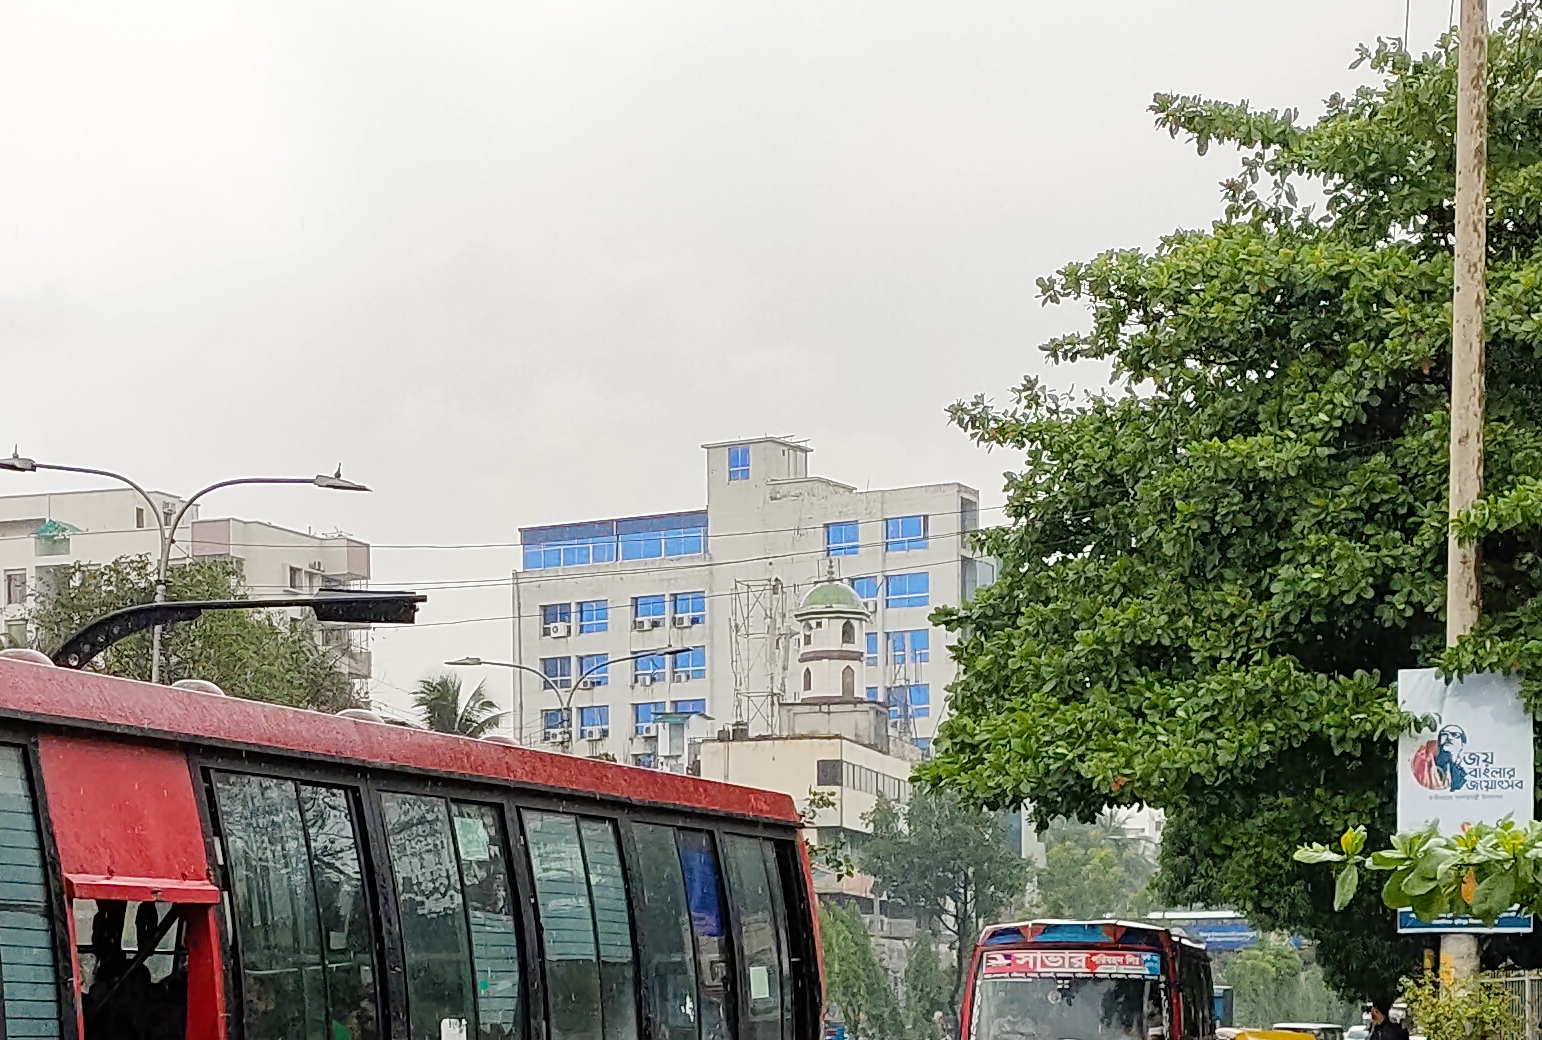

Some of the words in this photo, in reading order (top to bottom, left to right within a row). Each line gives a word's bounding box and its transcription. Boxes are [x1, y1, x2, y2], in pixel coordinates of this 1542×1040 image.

[1462, 751, 1494, 767] জয়
[1467, 767, 1516, 780] বাংলার
[1011, 952, 1091, 970] সাভার
